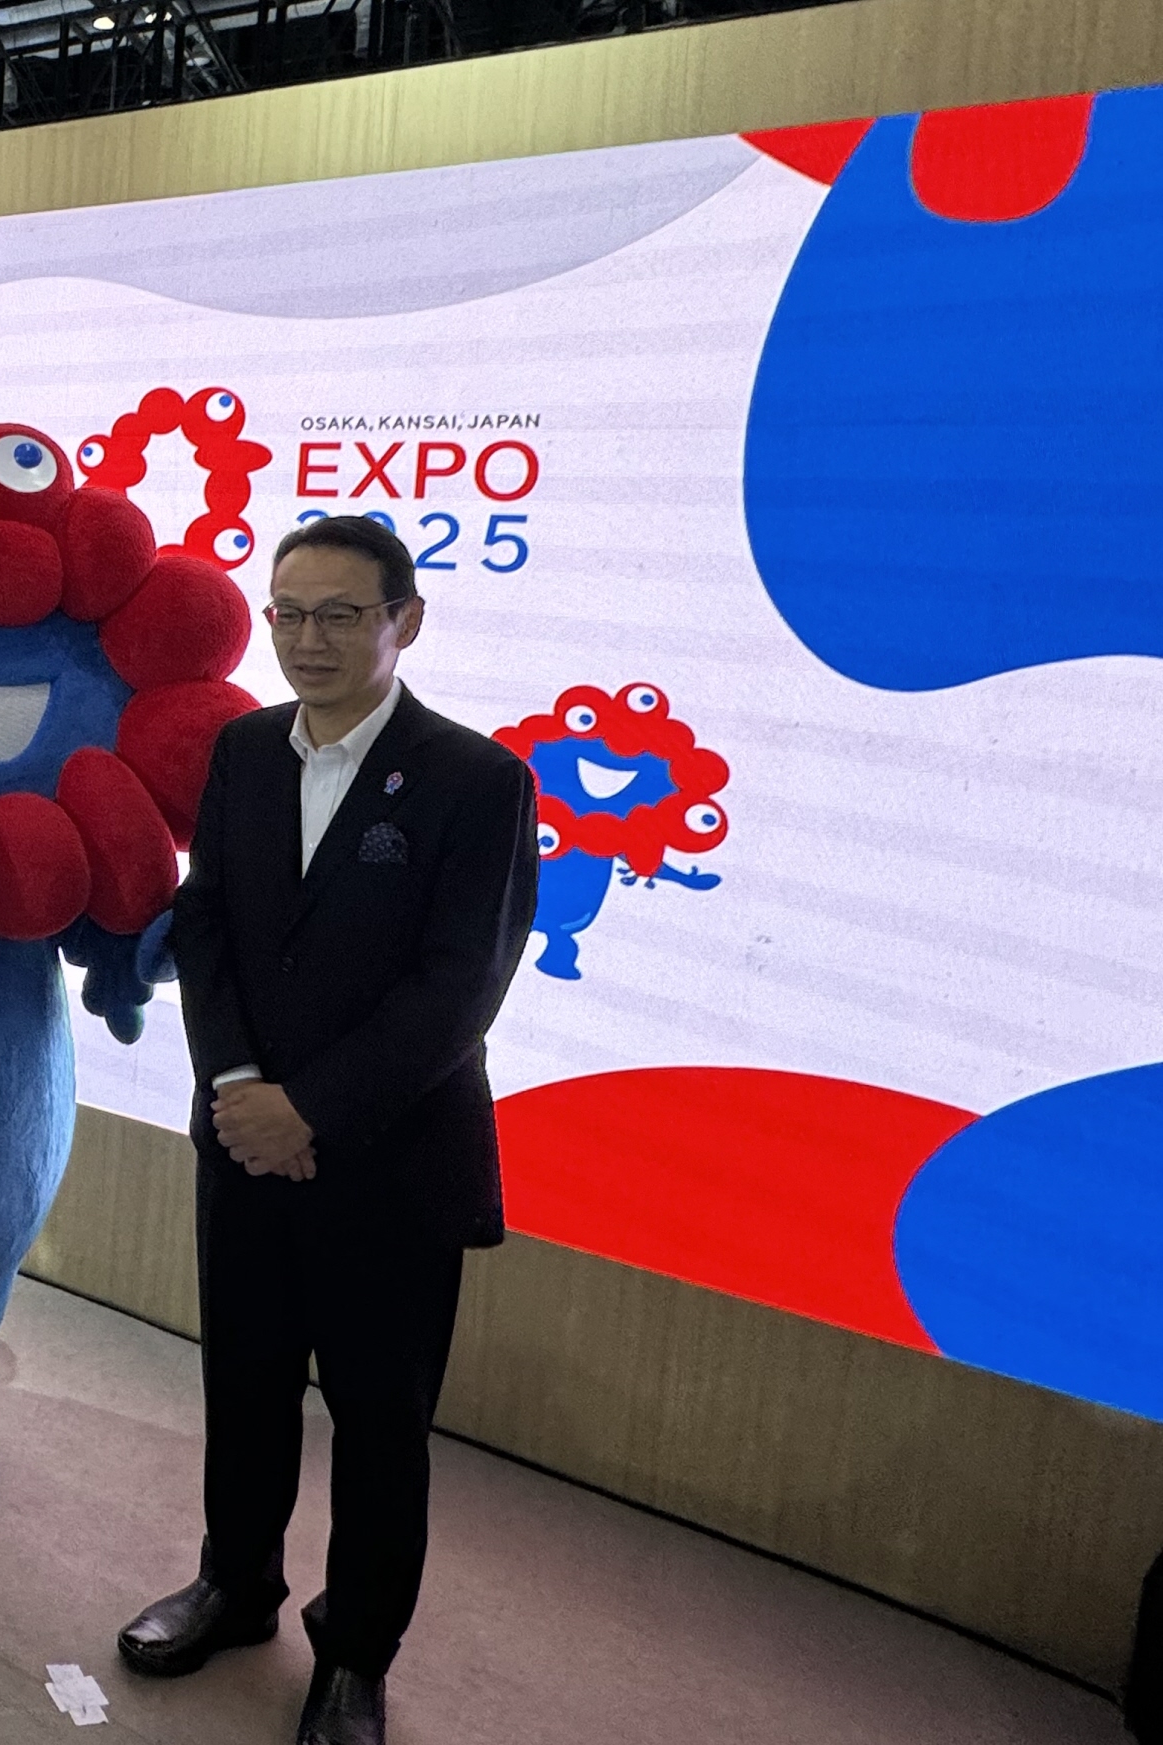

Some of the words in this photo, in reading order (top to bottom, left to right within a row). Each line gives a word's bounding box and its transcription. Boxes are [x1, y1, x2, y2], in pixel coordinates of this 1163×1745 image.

[301, 416, 374, 432] OSAKA,
[378, 414, 463, 432] KANSAI,
[467, 413, 541, 430] JAPAN
[296, 439, 540, 503] EXPO
